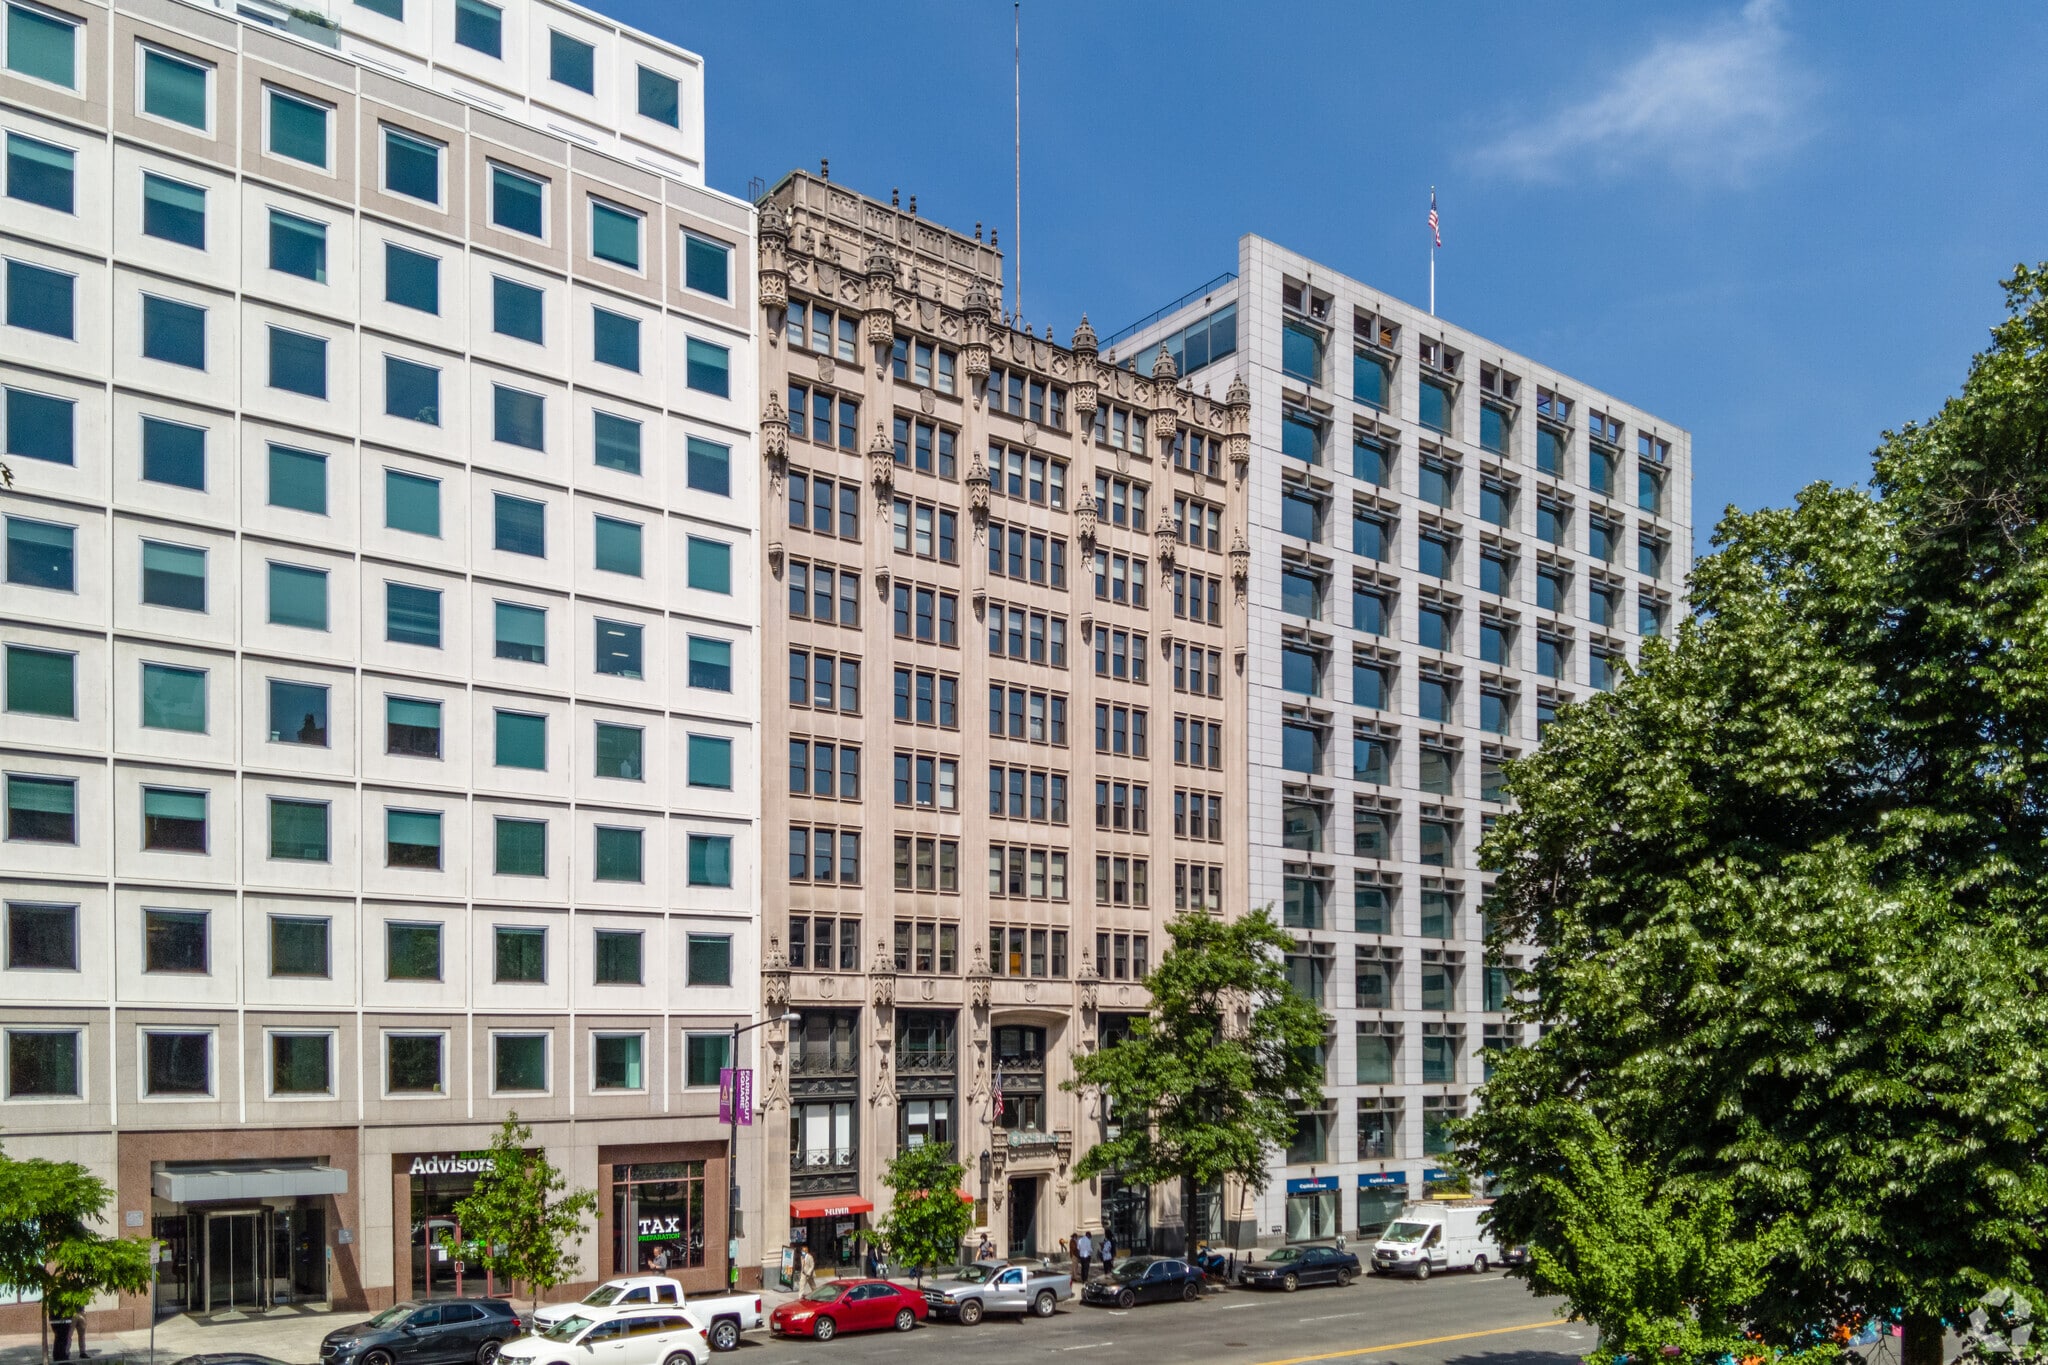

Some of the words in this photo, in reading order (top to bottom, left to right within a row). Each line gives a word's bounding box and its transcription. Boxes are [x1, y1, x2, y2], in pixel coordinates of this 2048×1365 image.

[410, 1155, 496, 1174] Advisors
[639, 1217, 680, 1235] TAX
[638, 1233, 680, 1242] PREPARATION
